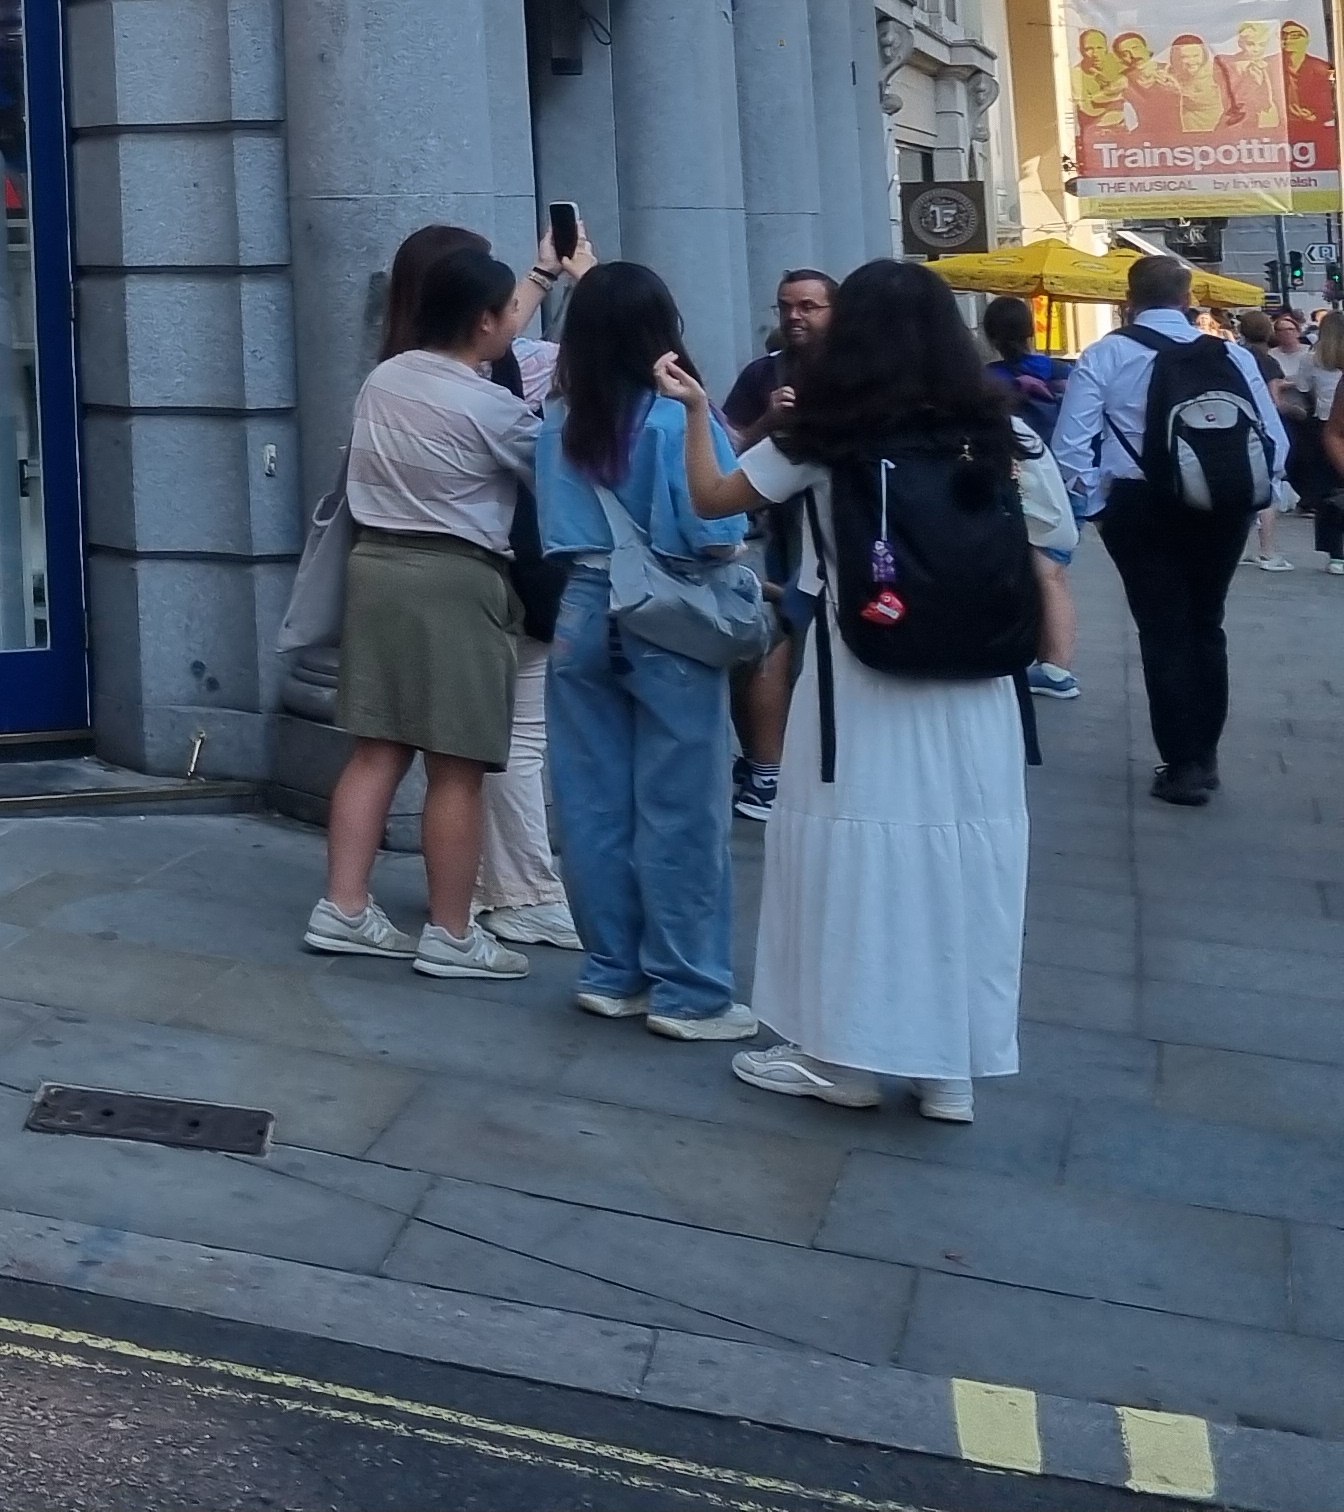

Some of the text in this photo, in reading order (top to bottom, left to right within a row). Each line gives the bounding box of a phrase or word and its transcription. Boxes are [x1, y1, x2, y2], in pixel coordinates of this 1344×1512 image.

[1093, 137, 1316, 172] Trainspotting
[1097, 175, 1318, 194] THE MUSICAL by Irvine Welsh
